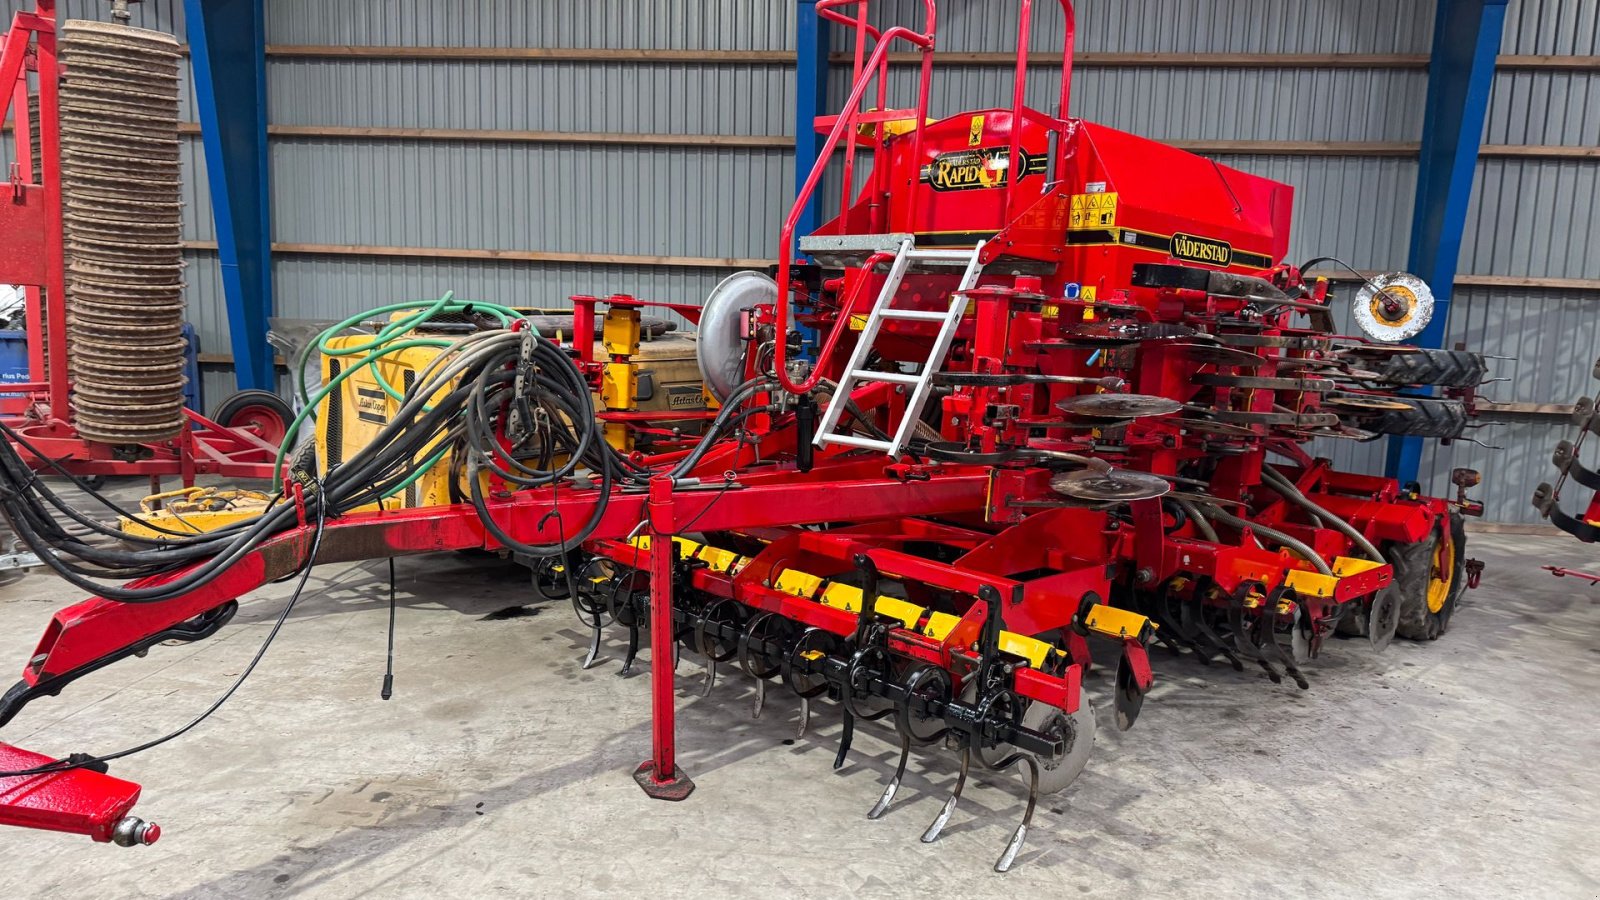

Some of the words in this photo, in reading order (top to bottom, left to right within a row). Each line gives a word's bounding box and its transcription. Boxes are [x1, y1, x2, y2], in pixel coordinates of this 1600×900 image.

[937, 161, 979, 187] RAPID
[1175, 236, 1228, 262] VÄDERSTAD
[672, 396, 695, 405] Atlas
